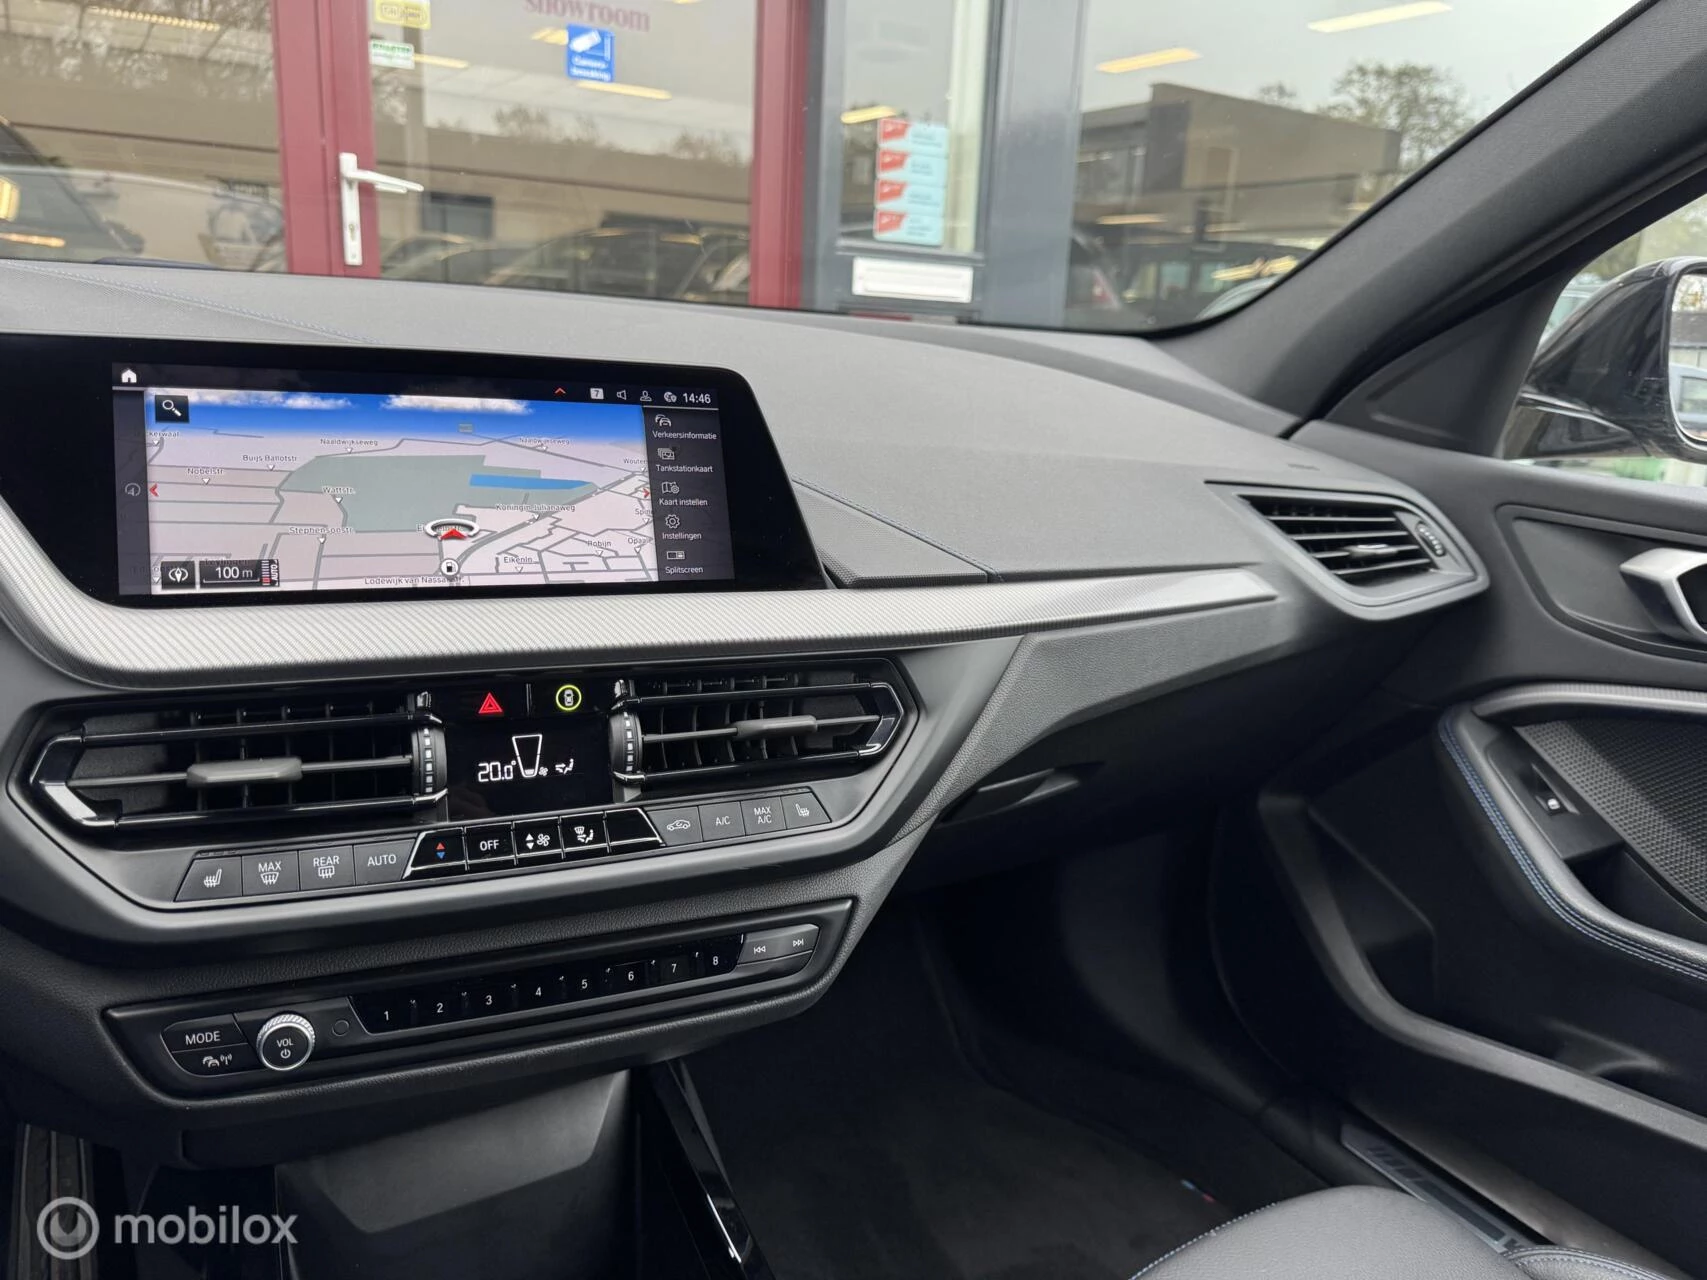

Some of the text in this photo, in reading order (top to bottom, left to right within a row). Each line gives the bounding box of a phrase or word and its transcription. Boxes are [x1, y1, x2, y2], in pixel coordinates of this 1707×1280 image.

[682, 393, 711, 404] 14:46
[652, 431, 717, 440] Verkeersinformatie
[656, 464, 713, 473] Tankstationkaart
[659, 498, 708, 506] Kaart instellen
[662, 532, 702, 541] Instellingen
[587, 539, 612, 548] Robijn
[215, 567, 253, 579] 100 m
[665, 566, 704, 575] Splitscreen
[364, 575, 404, 585] Lodewijk
[753, 806, 772, 816] MAX
[715, 816, 731, 826] A/C
[757, 815, 772, 825] A/C
[480, 840, 500, 851] OFF
[313, 855, 340, 867] REAR
[367, 854, 397, 867] AUTO
[258, 861, 282, 873] MAX
[384, 955, 719, 1021] 1 2 3 4 5 6 7 8
[185, 1031, 221, 1046] MODE
[276, 1038, 294, 1048] VOL
